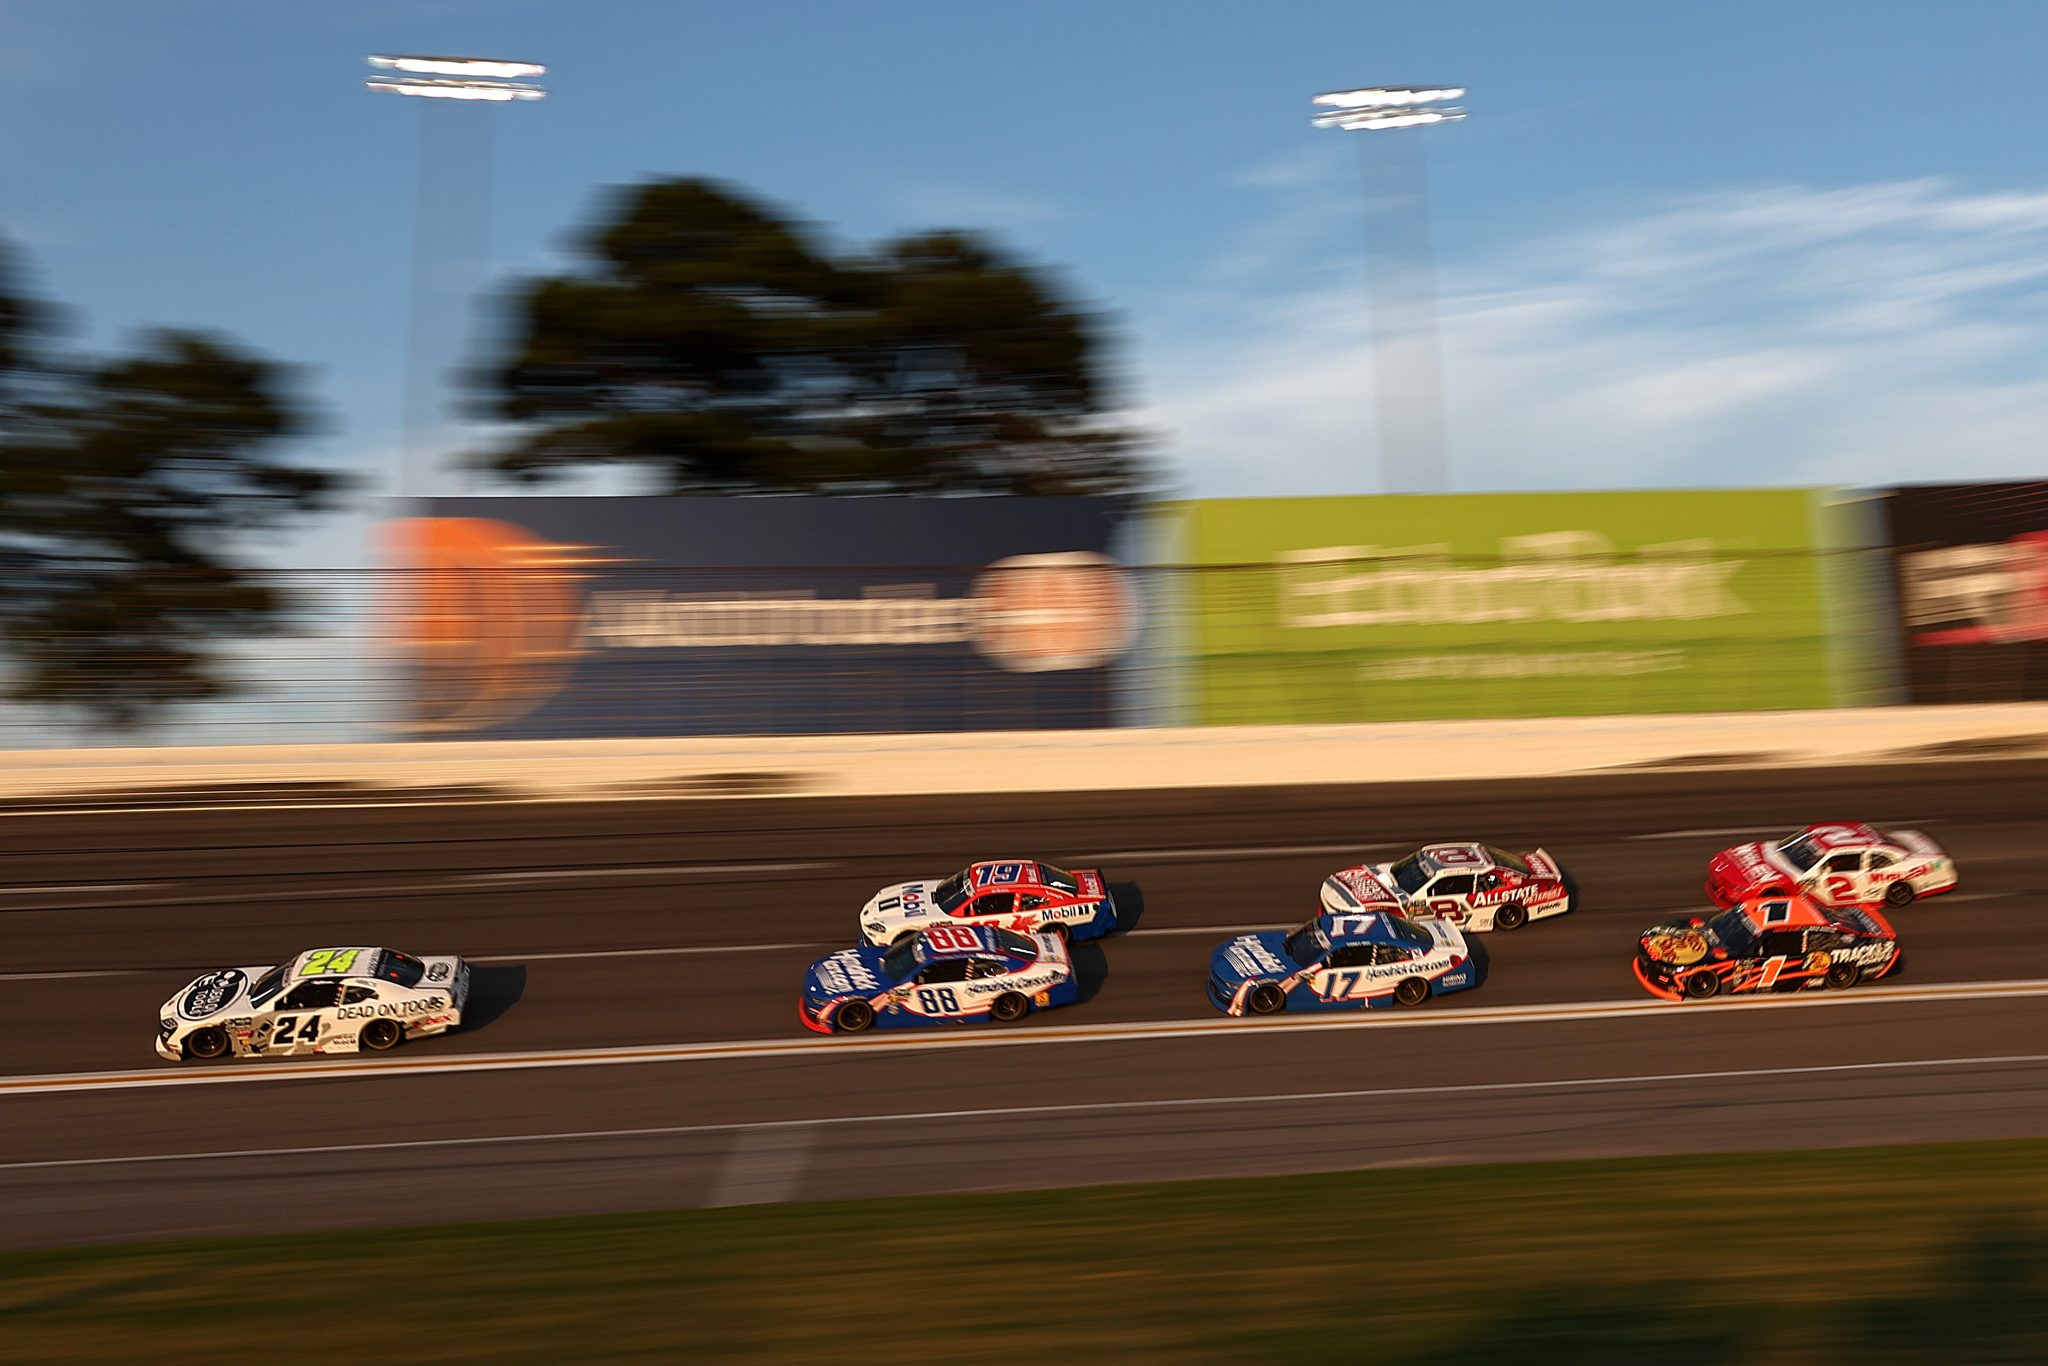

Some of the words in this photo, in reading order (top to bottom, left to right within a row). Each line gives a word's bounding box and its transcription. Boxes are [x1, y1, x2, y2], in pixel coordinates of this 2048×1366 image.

[977, 863, 1022, 887] 19
[902, 883, 927, 918] Mobil
[1473, 884, 1539, 908] ALLSTATE
[1827, 876, 1857, 902] 2
[1042, 906, 1077, 921] Mobil
[1757, 899, 1792, 926] 1
[1330, 914, 1377, 938] 17
[927, 927, 979, 951] 88
[300, 949, 360, 976] 24
[1756, 954, 1787, 988] 1
[1319, 971, 1361, 1003] 17
[337, 1006, 375, 1020] DEAD
[377, 1003, 398, 1017] ON
[401, 996, 445, 1016] TOOLS
[918, 988, 960, 1013] 88
[272, 1015, 321, 1044] 24
